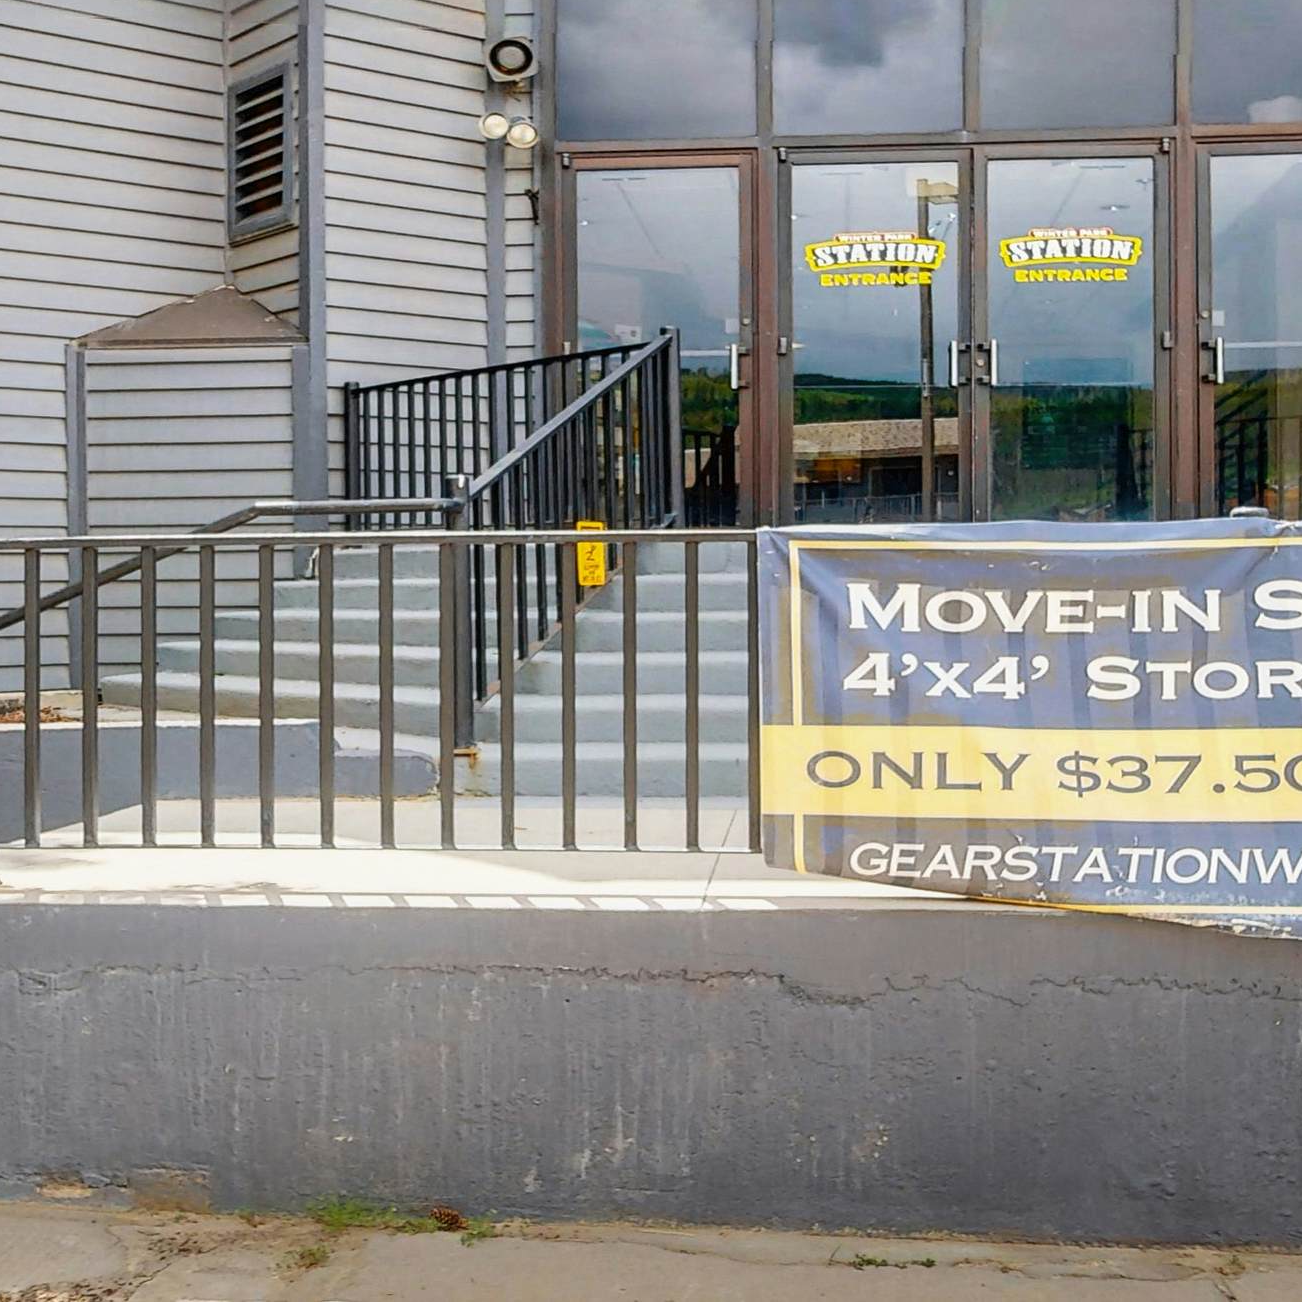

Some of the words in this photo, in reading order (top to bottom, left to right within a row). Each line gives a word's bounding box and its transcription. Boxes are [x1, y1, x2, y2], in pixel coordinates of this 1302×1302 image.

[814, 243, 936, 266] STATION
[1009, 238, 1133, 262] STATION
[820, 272, 931, 286] ENTRANCE
[1015, 268, 1127, 282] ENTRANCE
[847, 582, 1222, 634] MOVE-IN
[806, 750, 1031, 791] ONLY
